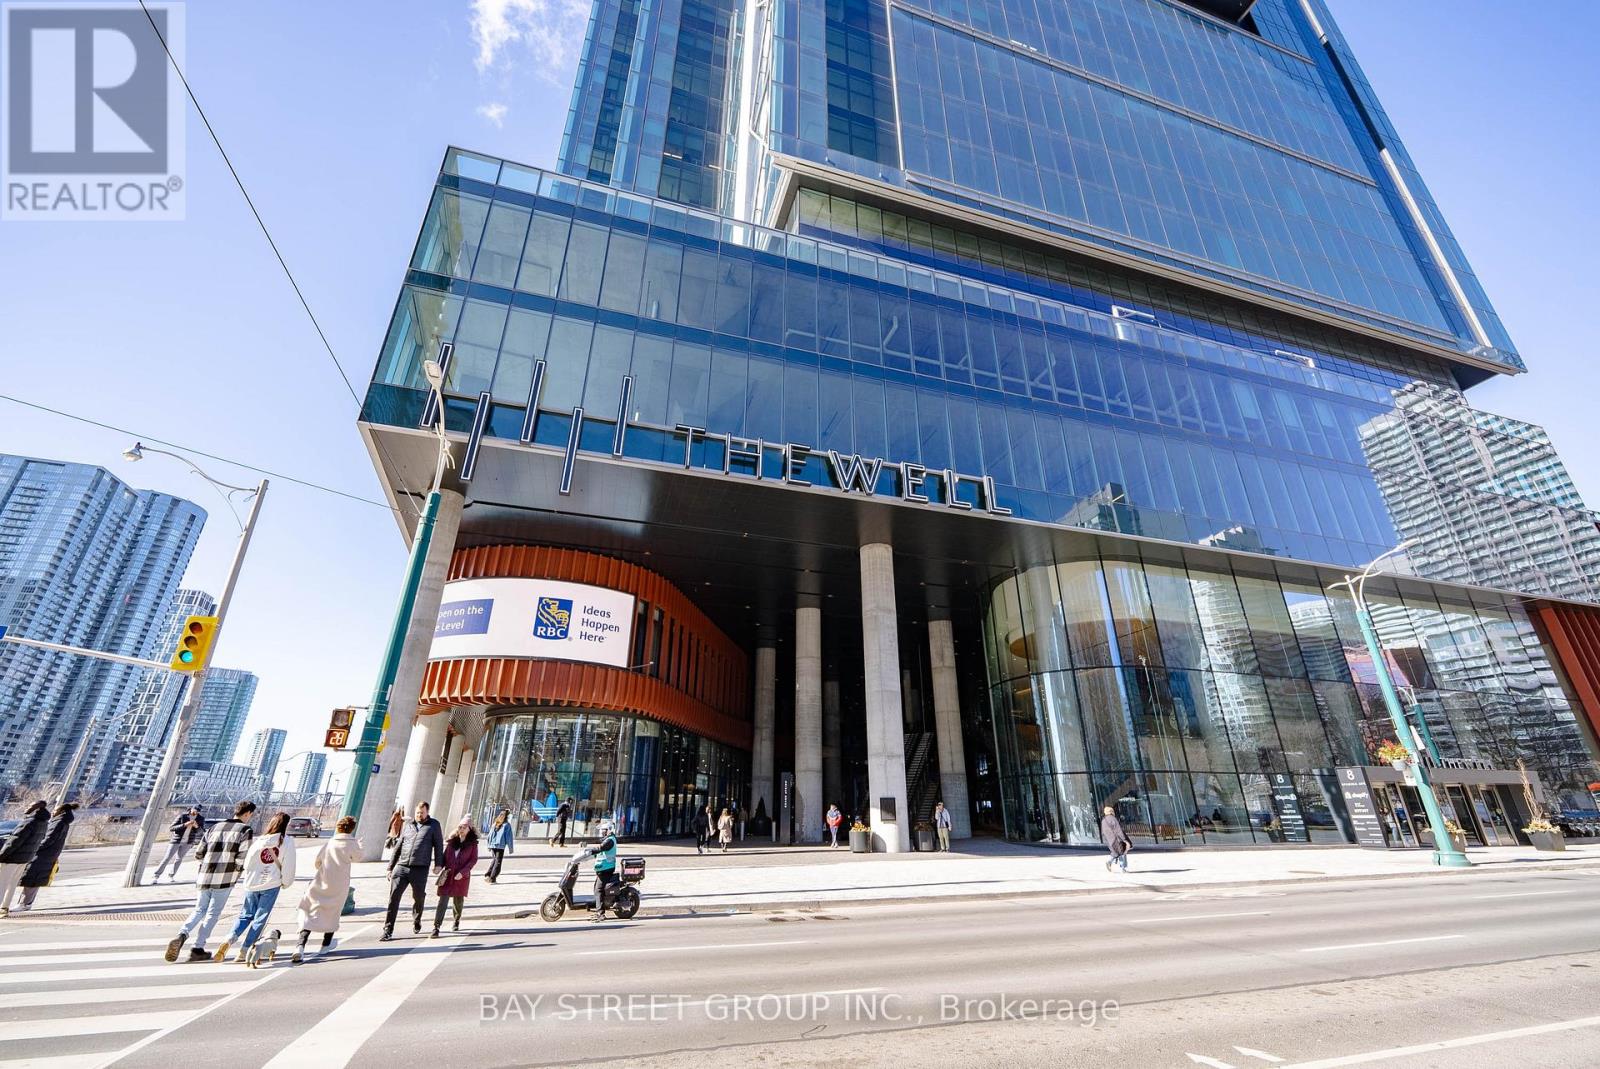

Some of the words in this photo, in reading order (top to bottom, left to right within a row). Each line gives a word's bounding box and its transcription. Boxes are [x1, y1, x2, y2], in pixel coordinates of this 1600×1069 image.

[675, 423, 812, 487] THE
[828, 449, 1012, 516] WELL
[454, 608, 465, 616] on
[467, 605, 484, 615] the
[583, 605, 611, 619] Ideas
[441, 618, 465, 631] Level
[581, 618, 620, 633] Happen
[536, 626, 566, 638] RBC
[330, 731, 344, 745] 28
[1346, 769, 1355, 781] 8
